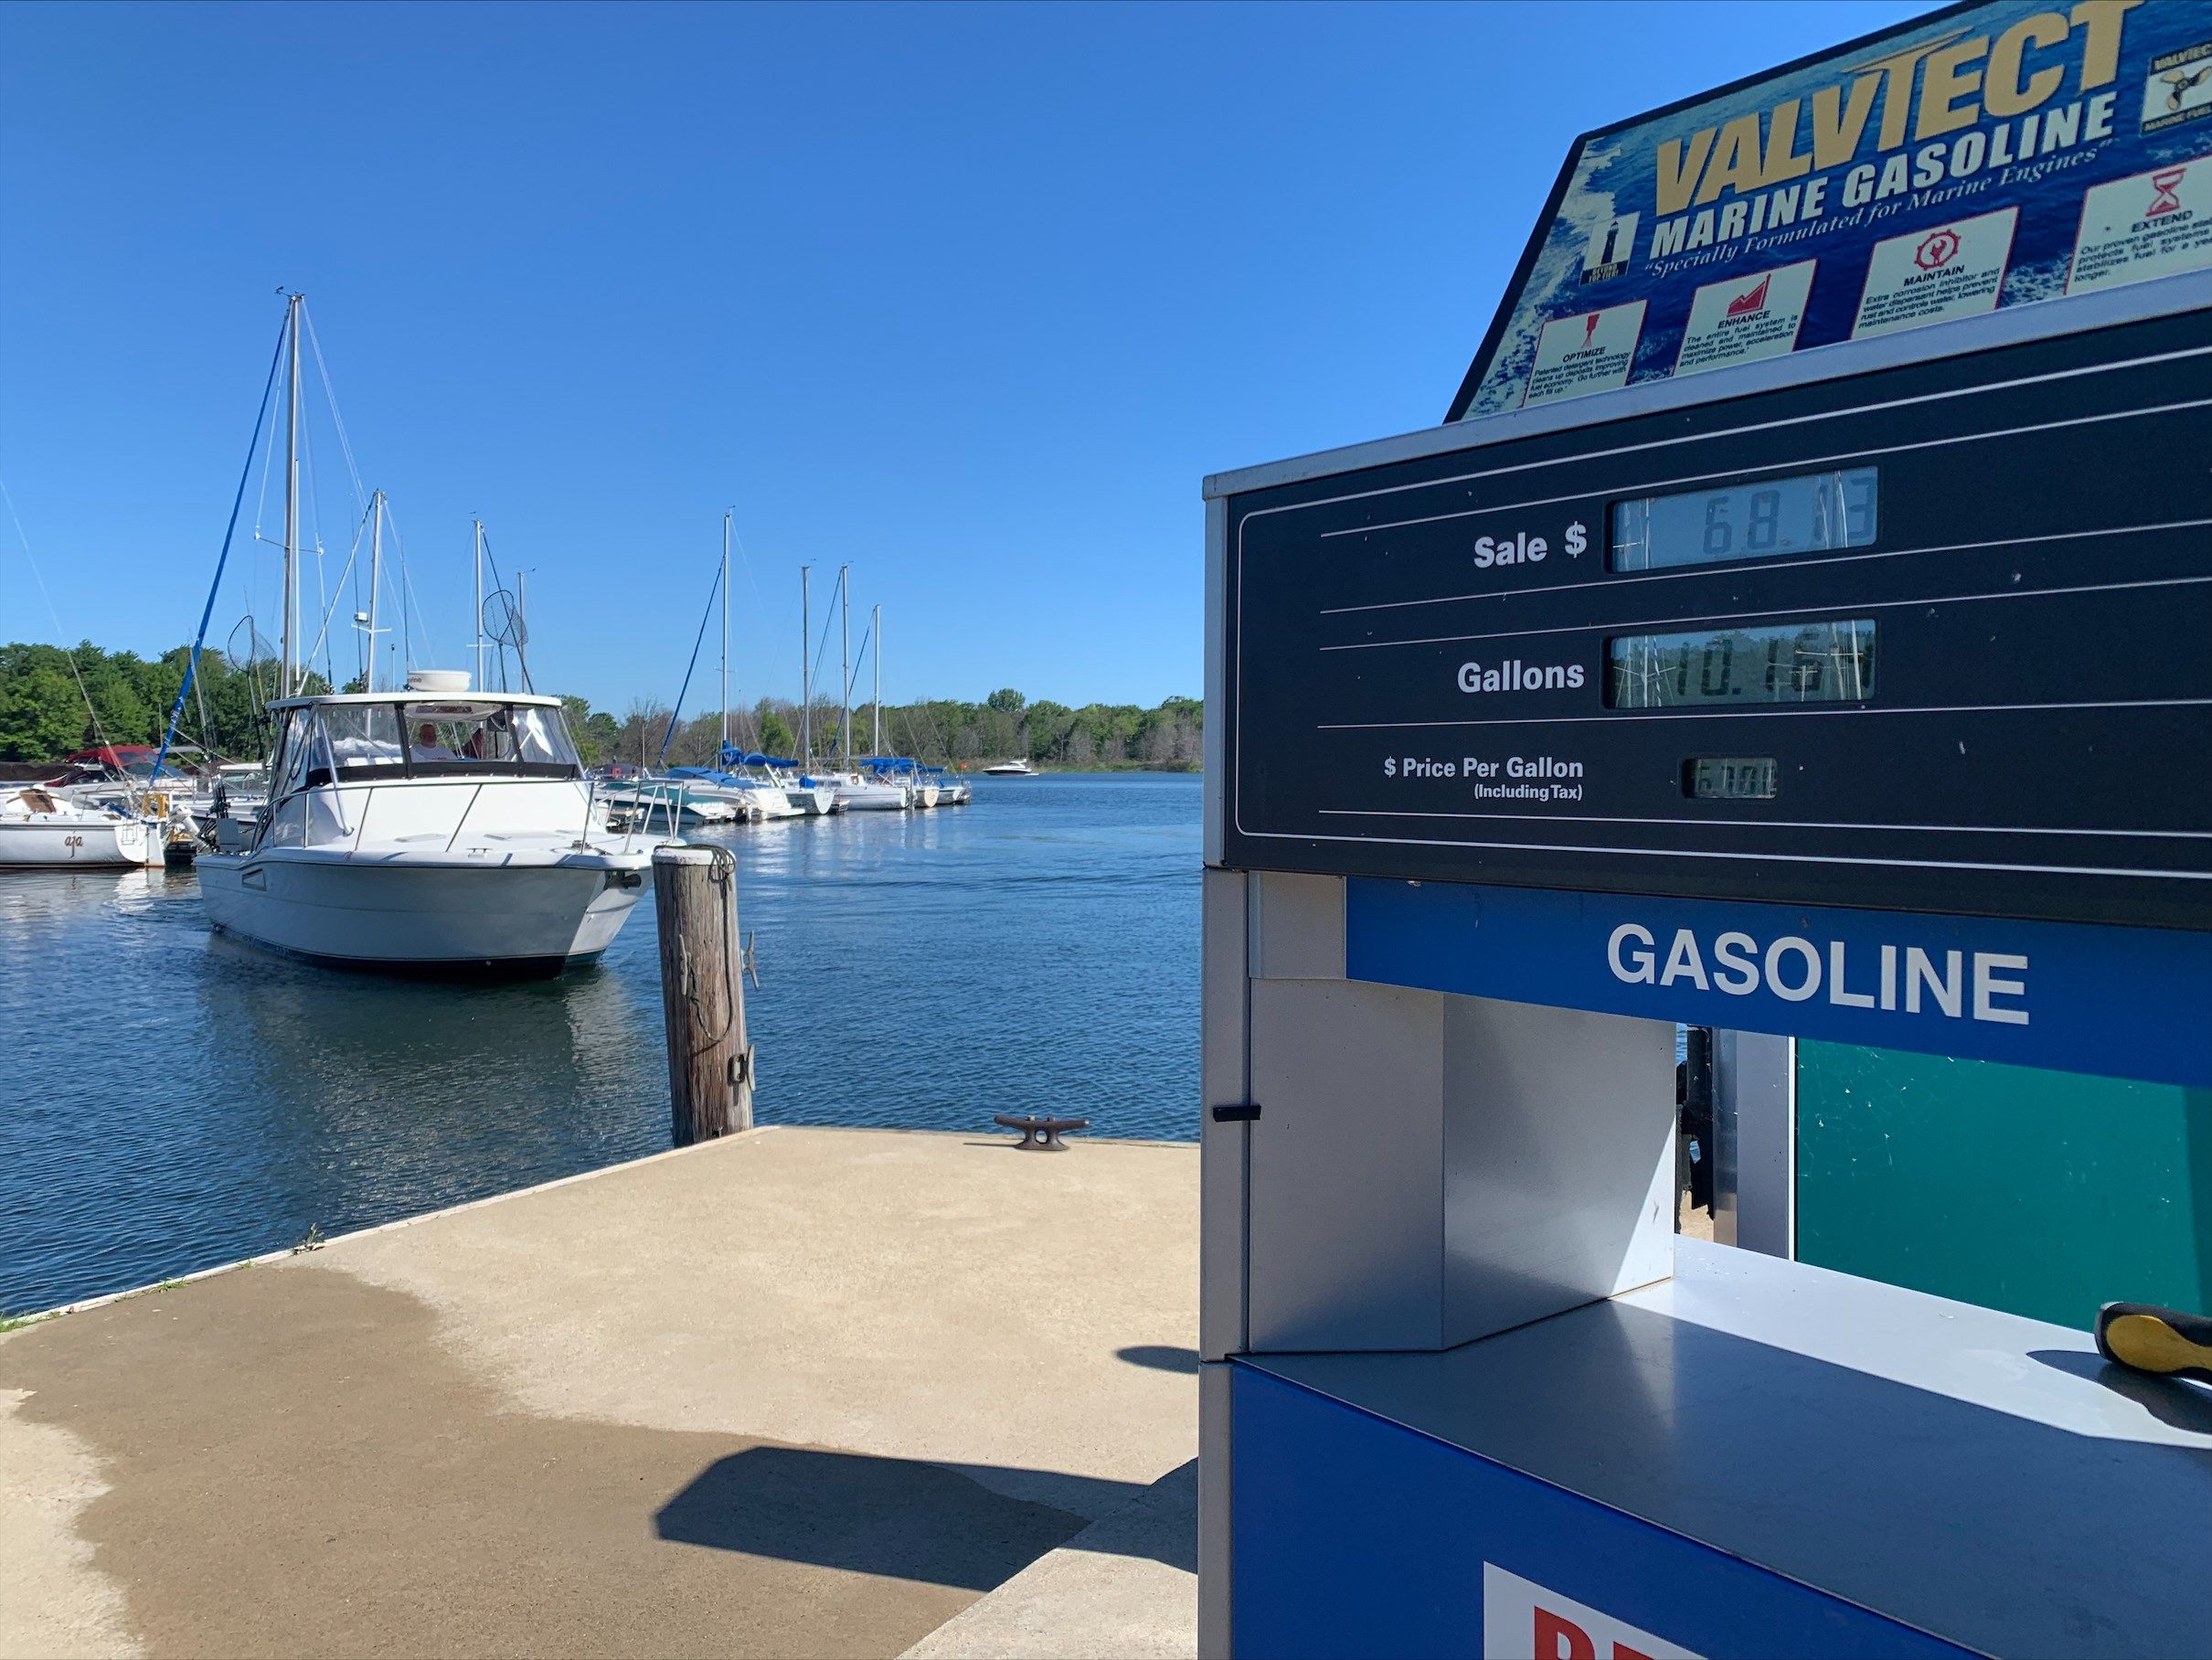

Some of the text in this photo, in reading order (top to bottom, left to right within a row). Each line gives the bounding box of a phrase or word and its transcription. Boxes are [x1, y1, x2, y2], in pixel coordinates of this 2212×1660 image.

[1654, 0, 2145, 217] VALVTECT
[1649, 91, 2117, 260] MARINE GASOLINE
[1744, 208, 1863, 254] Formulated
[1865, 201, 1901, 228] for
[1907, 176, 1991, 211] Marine
[2132, 210, 2193, 232] EXTEND
[1866, 293, 1889, 304] Extra
[1892, 283, 1936, 298] corrosion
[1981, 267, 2000, 278] and
[1903, 265, 1965, 287] MAINTAIN
[1962, 277, 1998, 291] prevent
[1958, 285, 1996, 299] lowering
[1707, 330, 1729, 340] entire
[1735, 325, 1750, 333] fuel
[1755, 318, 1785, 329] system
[1717, 311, 1771, 329] ENHANCE
[1681, 347, 1716, 360] maximize
[1746, 331, 1793, 346] acceleration
[1684, 341, 1713, 352] cleaned
[1718, 336, 1734, 345] and
[1739, 325, 1782, 340] maintained
[1563, 346, 1606, 363] OPTIMIZE
[1680, 358, 1694, 367] and
[1612, 367, 1627, 375] with
[1473, 521, 1587, 569] Sale $
[1457, 660, 1585, 693] Gallons
[1384, 756, 1584, 778] $ Price Per Gallon
[1473, 784, 1583, 802] (Including Tax)
[1607, 922, 2030, 1026] GASOLINE
